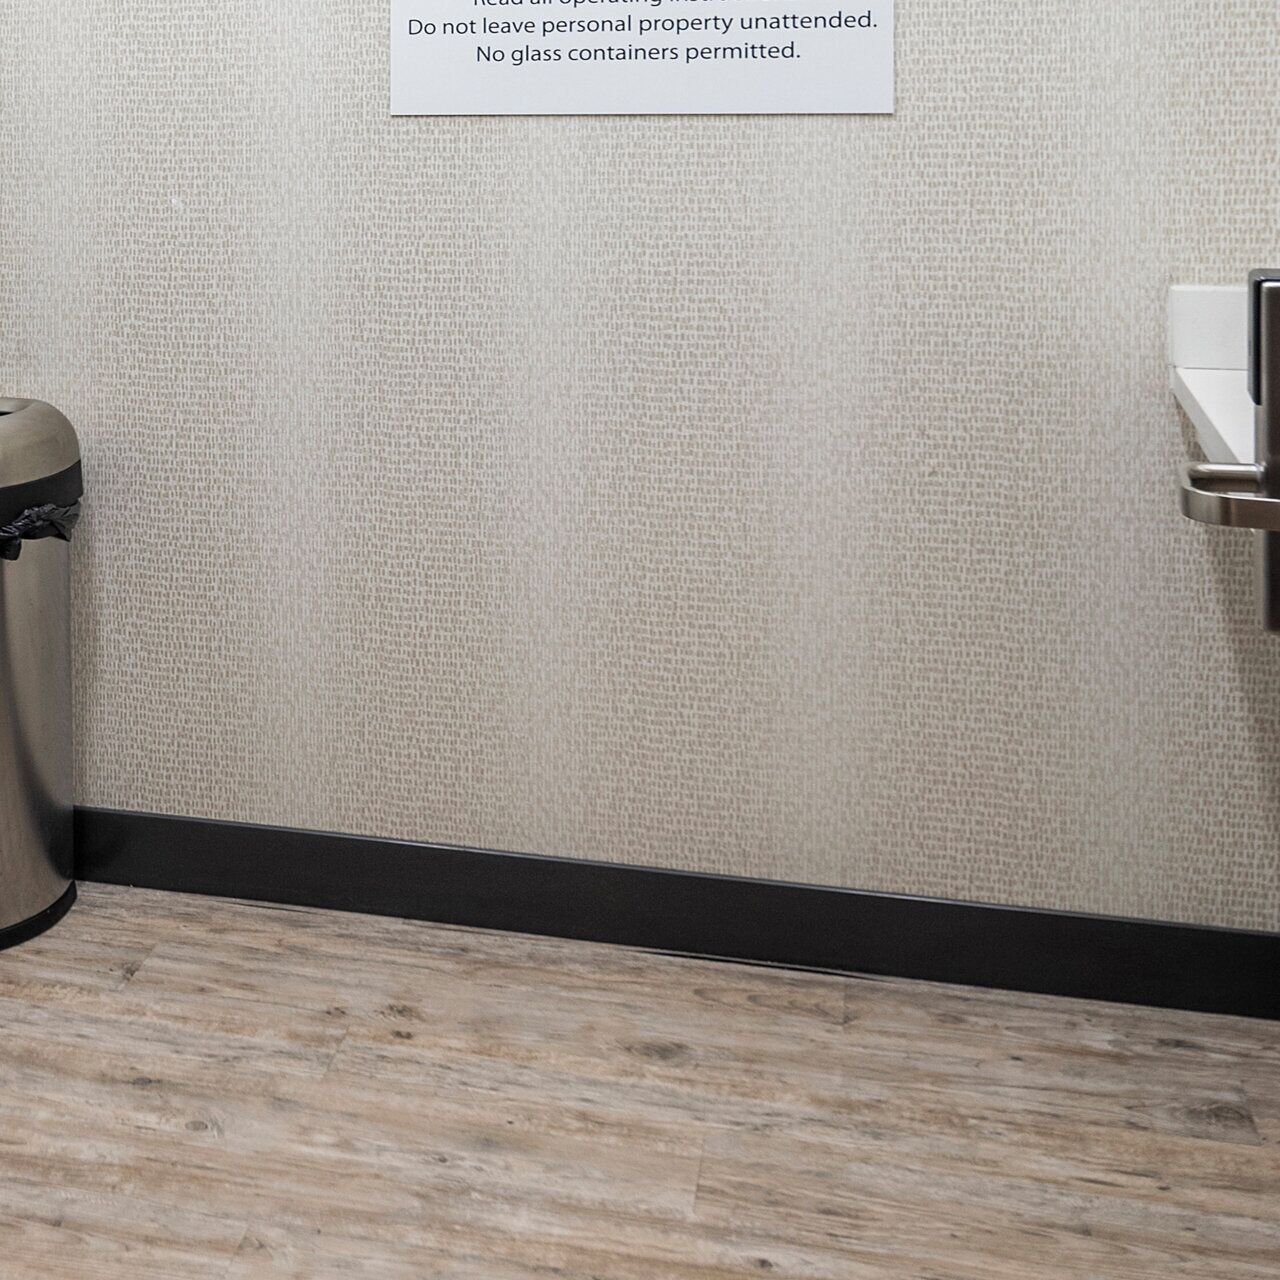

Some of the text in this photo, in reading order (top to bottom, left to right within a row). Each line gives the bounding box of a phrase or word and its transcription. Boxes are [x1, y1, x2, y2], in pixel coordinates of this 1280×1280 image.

[408, 9, 878, 38] Do not leave personal property unattended.
[476, 40, 801, 67] No glass containers permitted.
